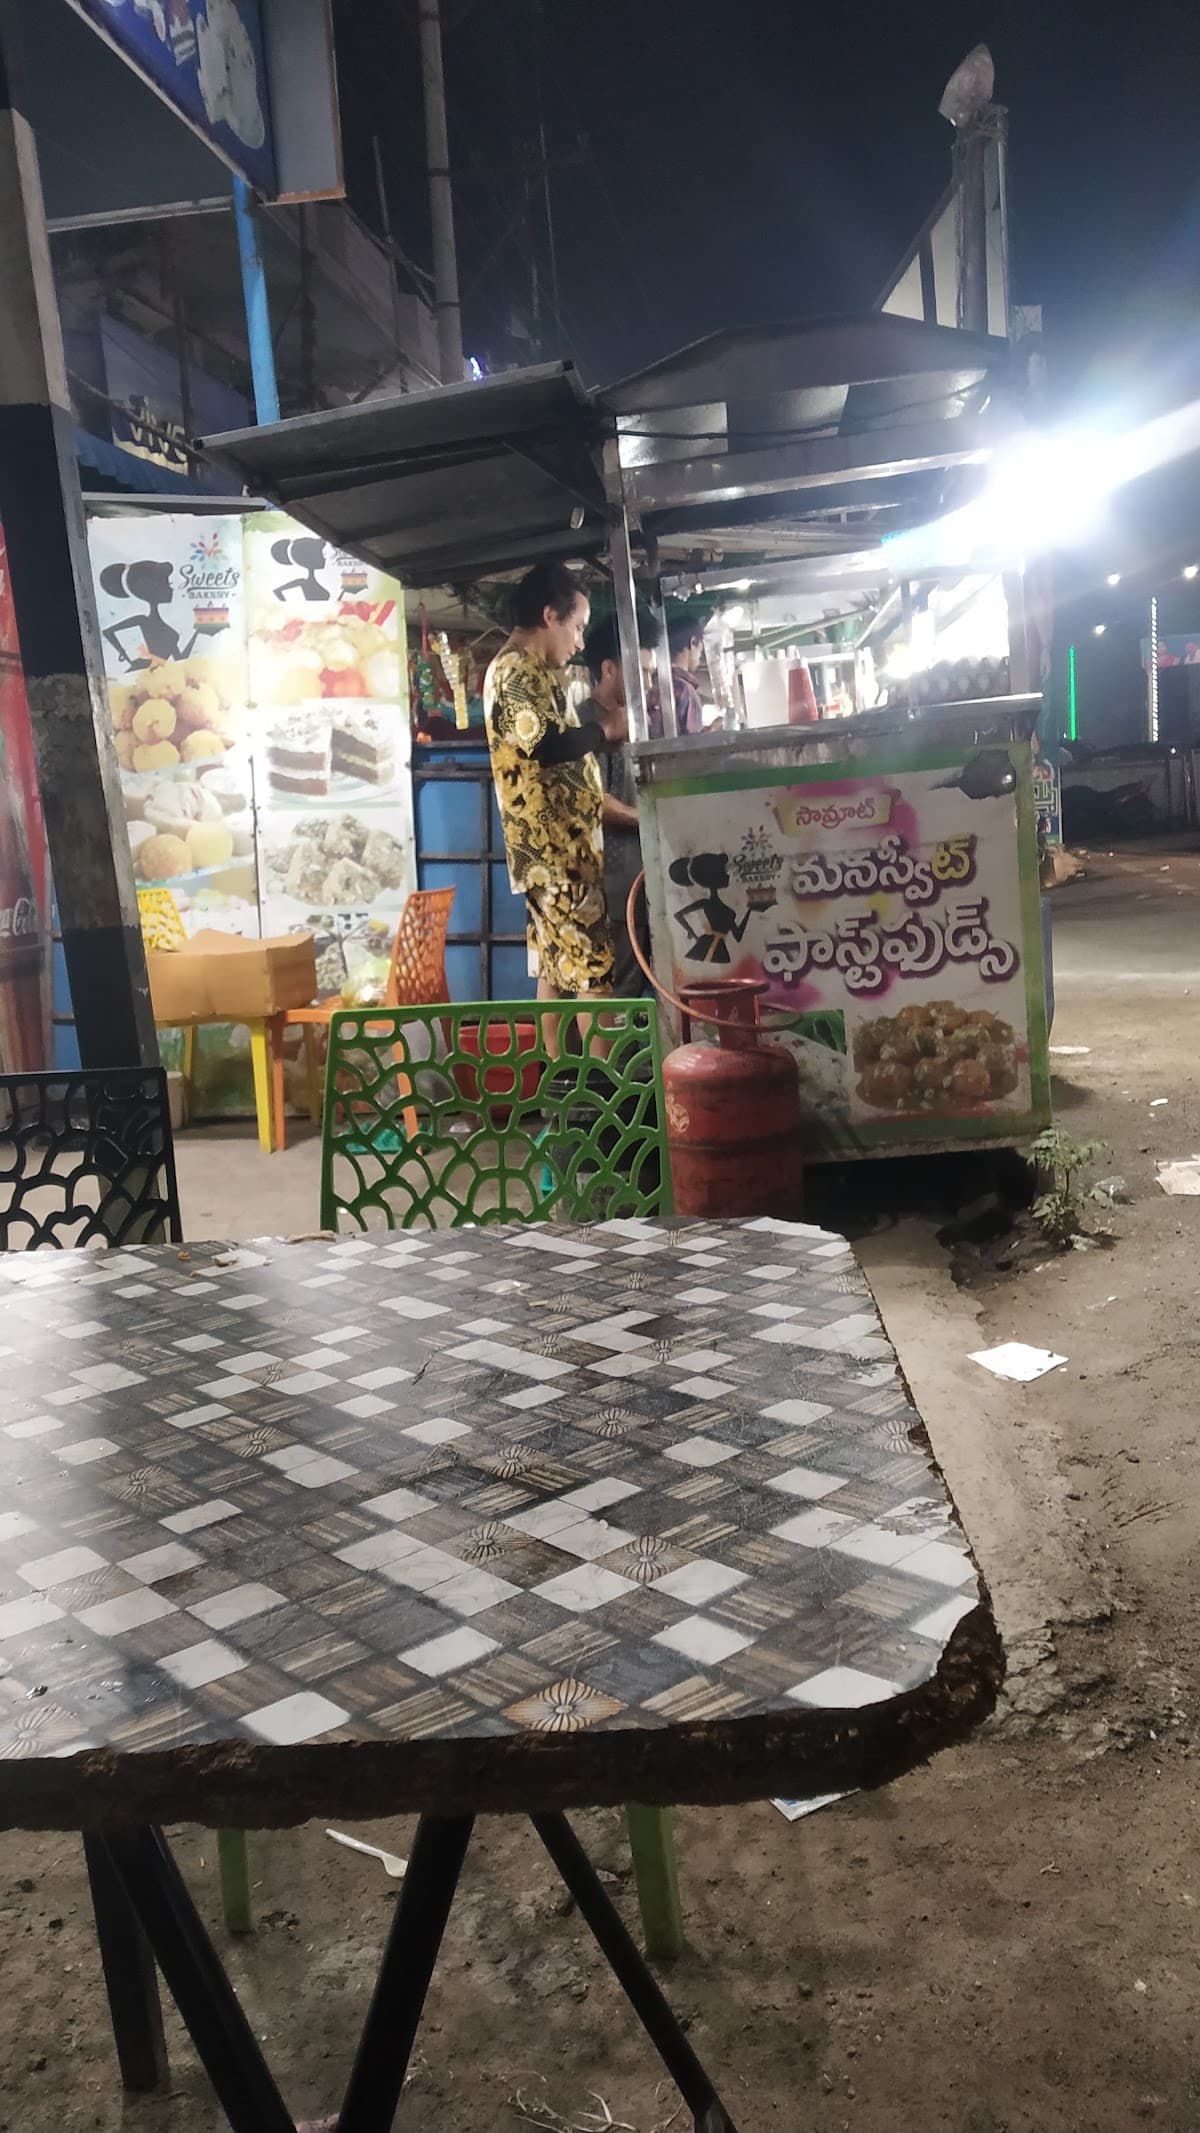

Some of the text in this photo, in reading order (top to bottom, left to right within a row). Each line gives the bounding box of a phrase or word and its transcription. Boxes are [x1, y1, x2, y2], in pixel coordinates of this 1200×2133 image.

[178, 564, 240, 591] Sweets
[188, 591, 230, 600] BAKERY
[796, 798, 876, 829] సామ్రాట్
[733, 853, 784, 874] Sweets
